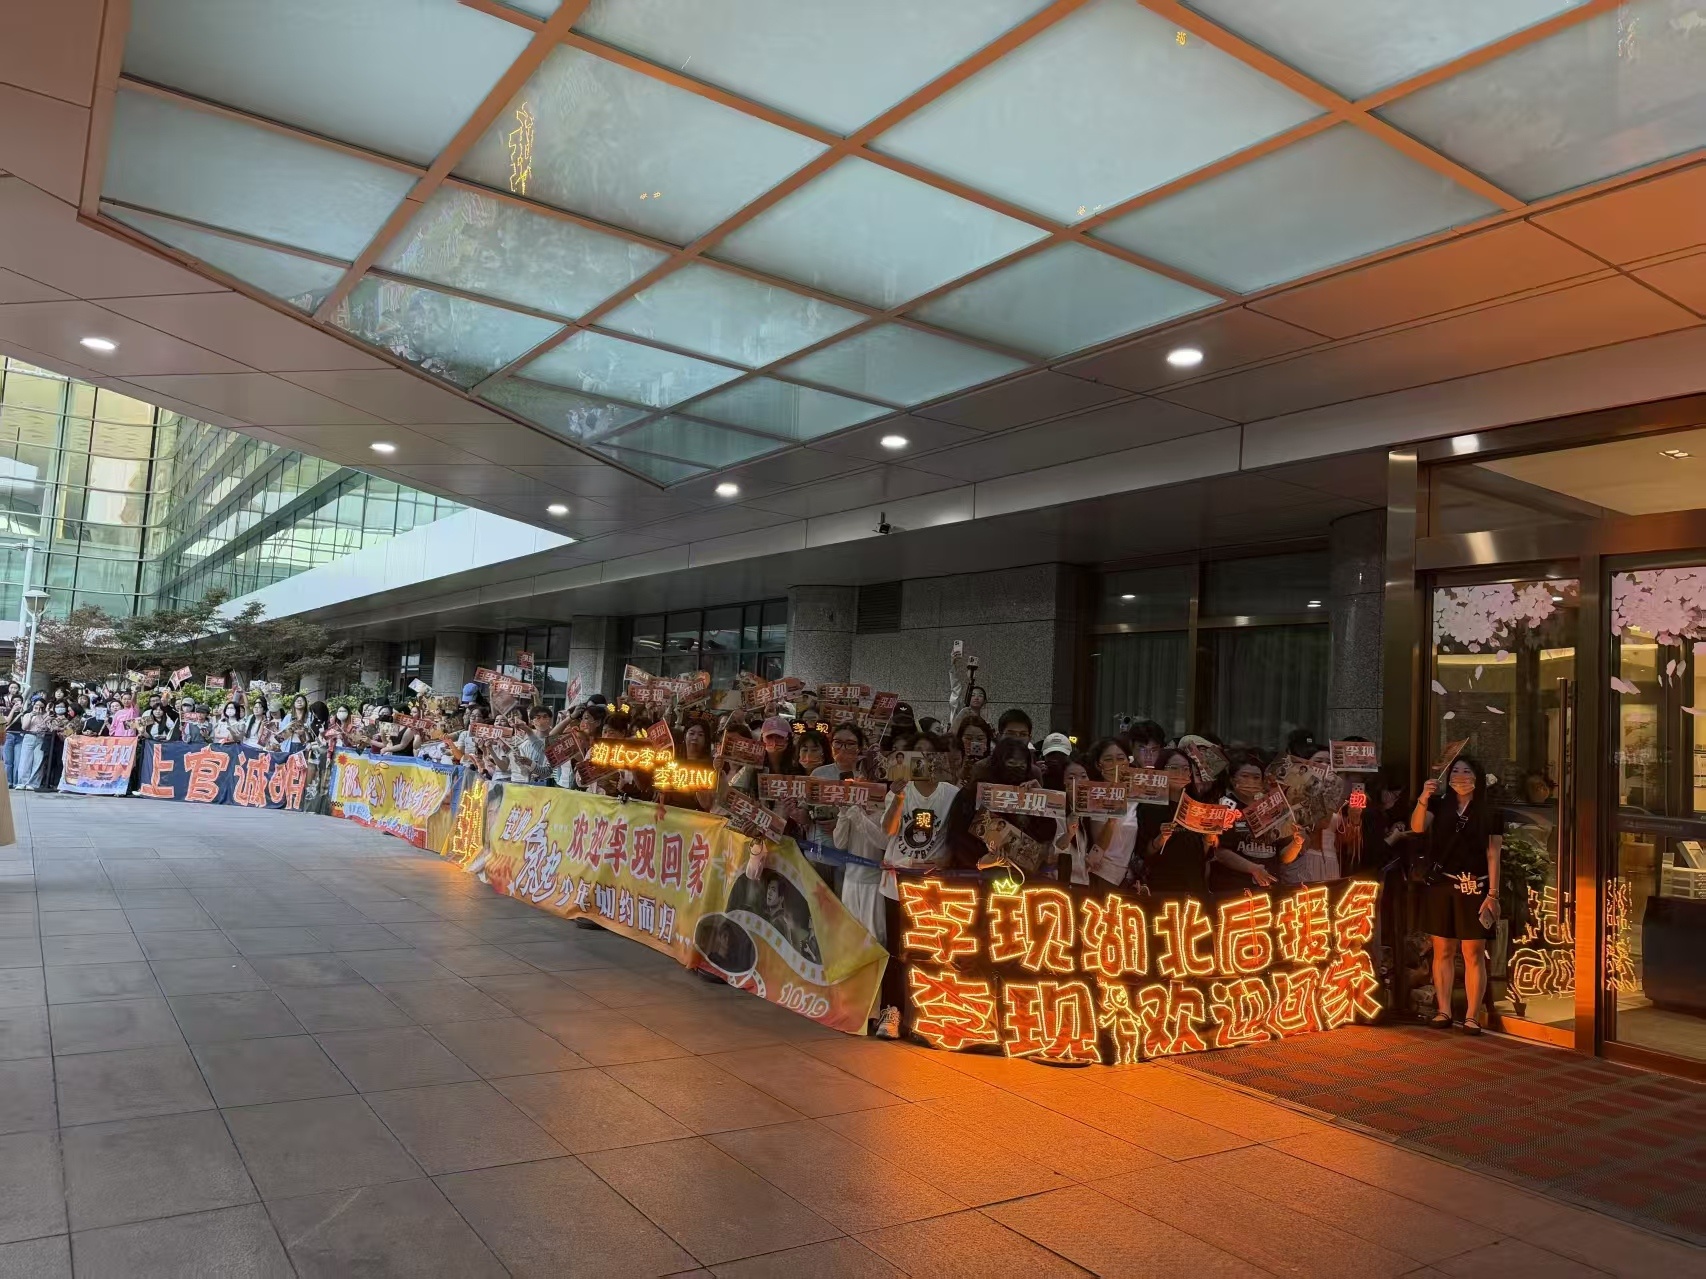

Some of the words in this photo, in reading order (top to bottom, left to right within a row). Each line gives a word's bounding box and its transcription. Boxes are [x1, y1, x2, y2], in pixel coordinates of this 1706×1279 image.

[637, 689, 664, 701] 李现
[757, 682, 787, 703] 李现
[829, 686, 861, 699] 李现
[592, 743, 624, 765] 湖北
[1345, 745, 1376, 757] 李现
[771, 779, 806, 799] 李现
[1133, 774, 1168, 788] 李现
[824, 785, 869, 807] 李现
[996, 791, 1047, 811] 李现
[1091, 787, 1125, 801] 李现
[1257, 791, 1283, 816] 李现
[735, 799, 773, 831] 李现
[1190, 806, 1226, 820] 李现
[566, 812, 710, 902] 欢迎李现回家
[901, 881, 1378, 977] 李现湖北后援会
[778, 982, 830, 1018] 1019
[912, 951, 1383, 1063] 李现欢迎回家
